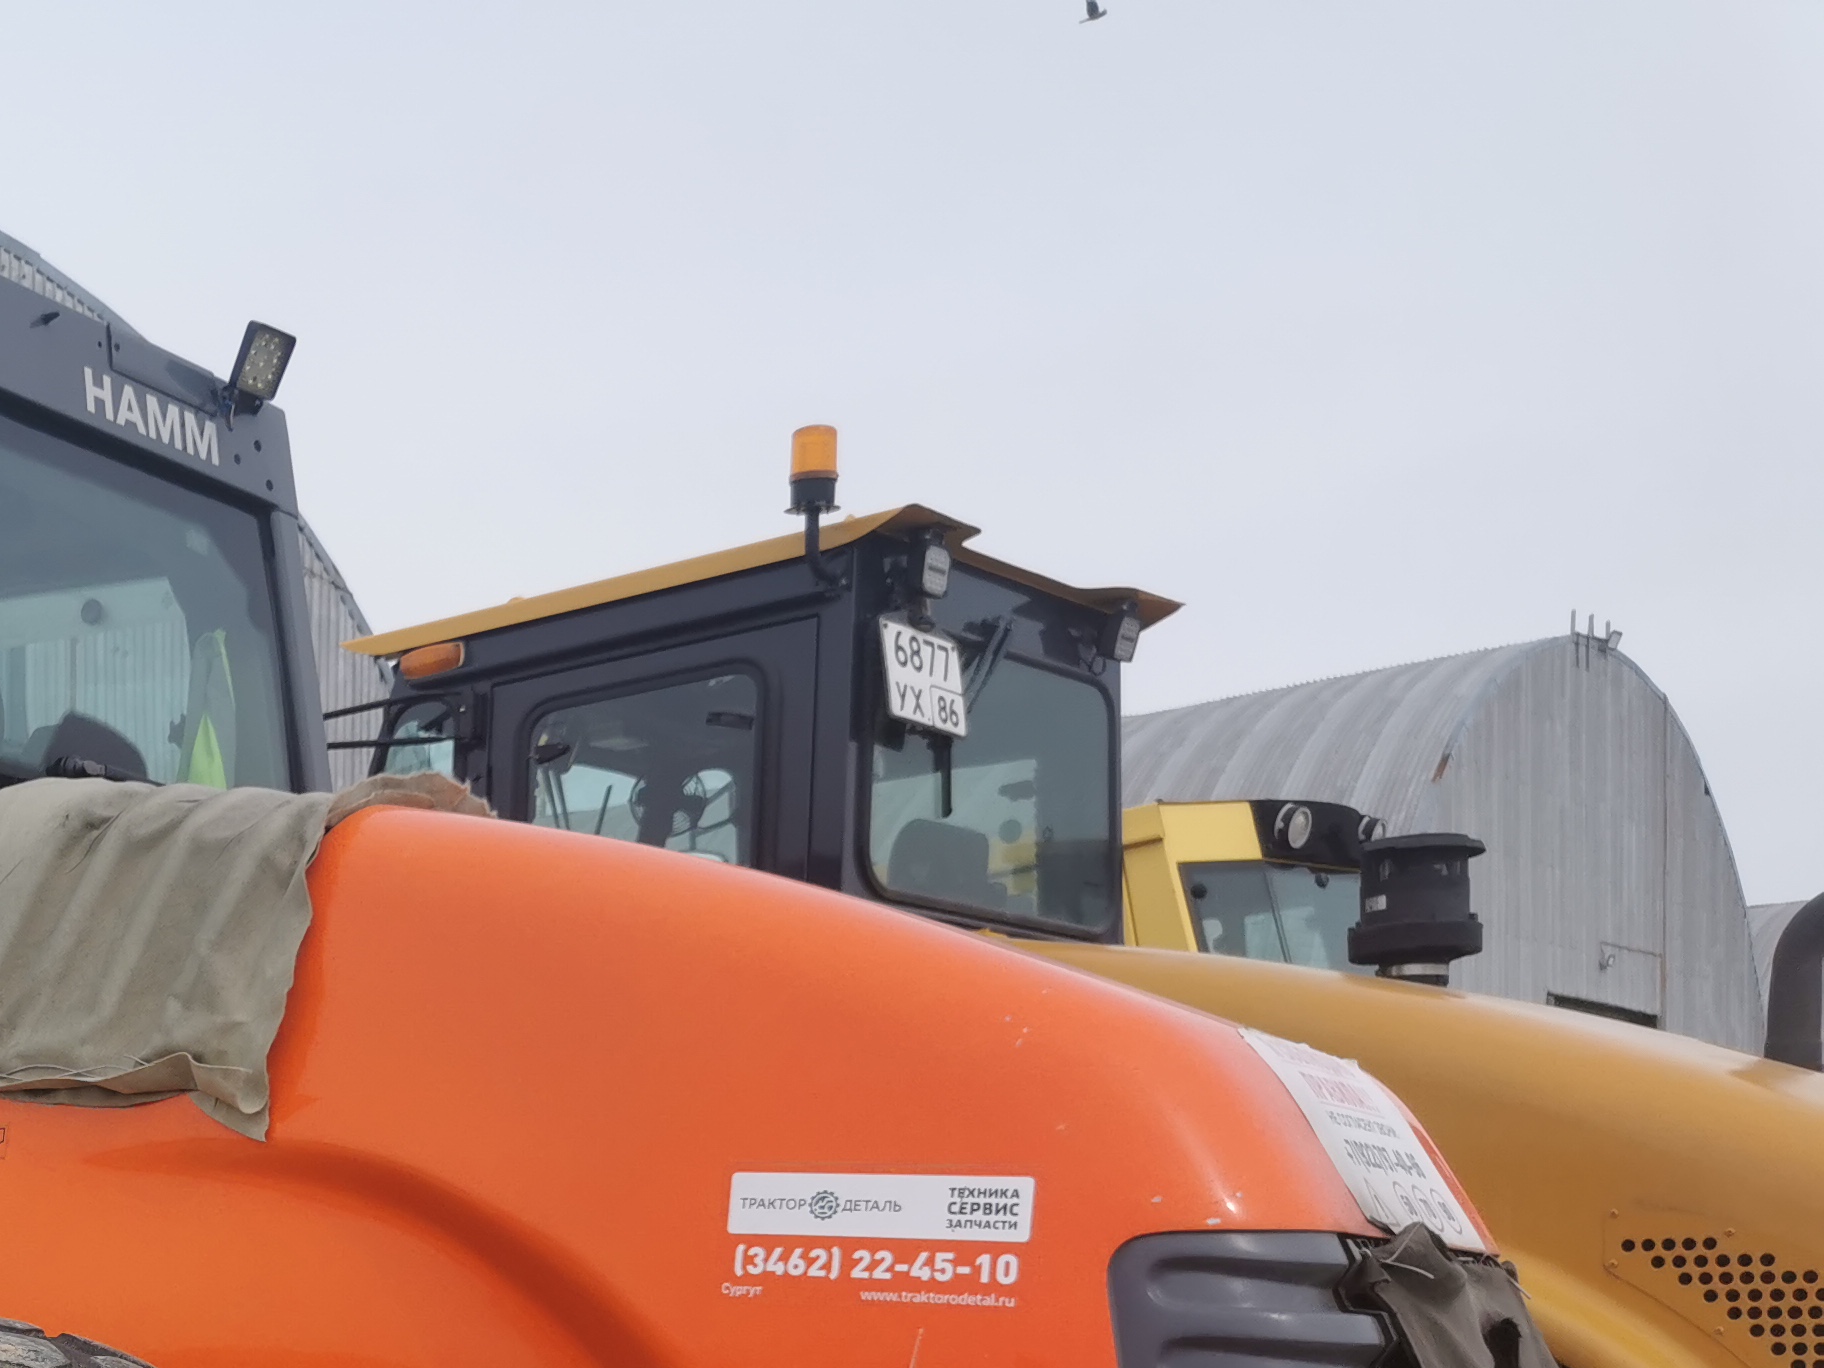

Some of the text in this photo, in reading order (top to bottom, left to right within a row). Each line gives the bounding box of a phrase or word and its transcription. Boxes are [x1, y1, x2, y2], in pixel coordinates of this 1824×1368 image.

[83, 365, 220, 467] HAMM
[894, 630, 950, 683] 6877
[937, 695, 960, 728] 86
[947, 1186, 1021, 1200] ТЕХНИКА
[739, 1196, 903, 1214] ТРАКТОР ДЕТАЛЬ
[946, 1201, 1020, 1217] СЕРВИС
[944, 1218, 1019, 1232] ЗАПЧАСТИ
[733, 1243, 1020, 1286] (3462) 22-45-10
[721, 1282, 763, 1299] Сургут
[859, 1289, 1017, 1308] www.traktorodetal.ru
